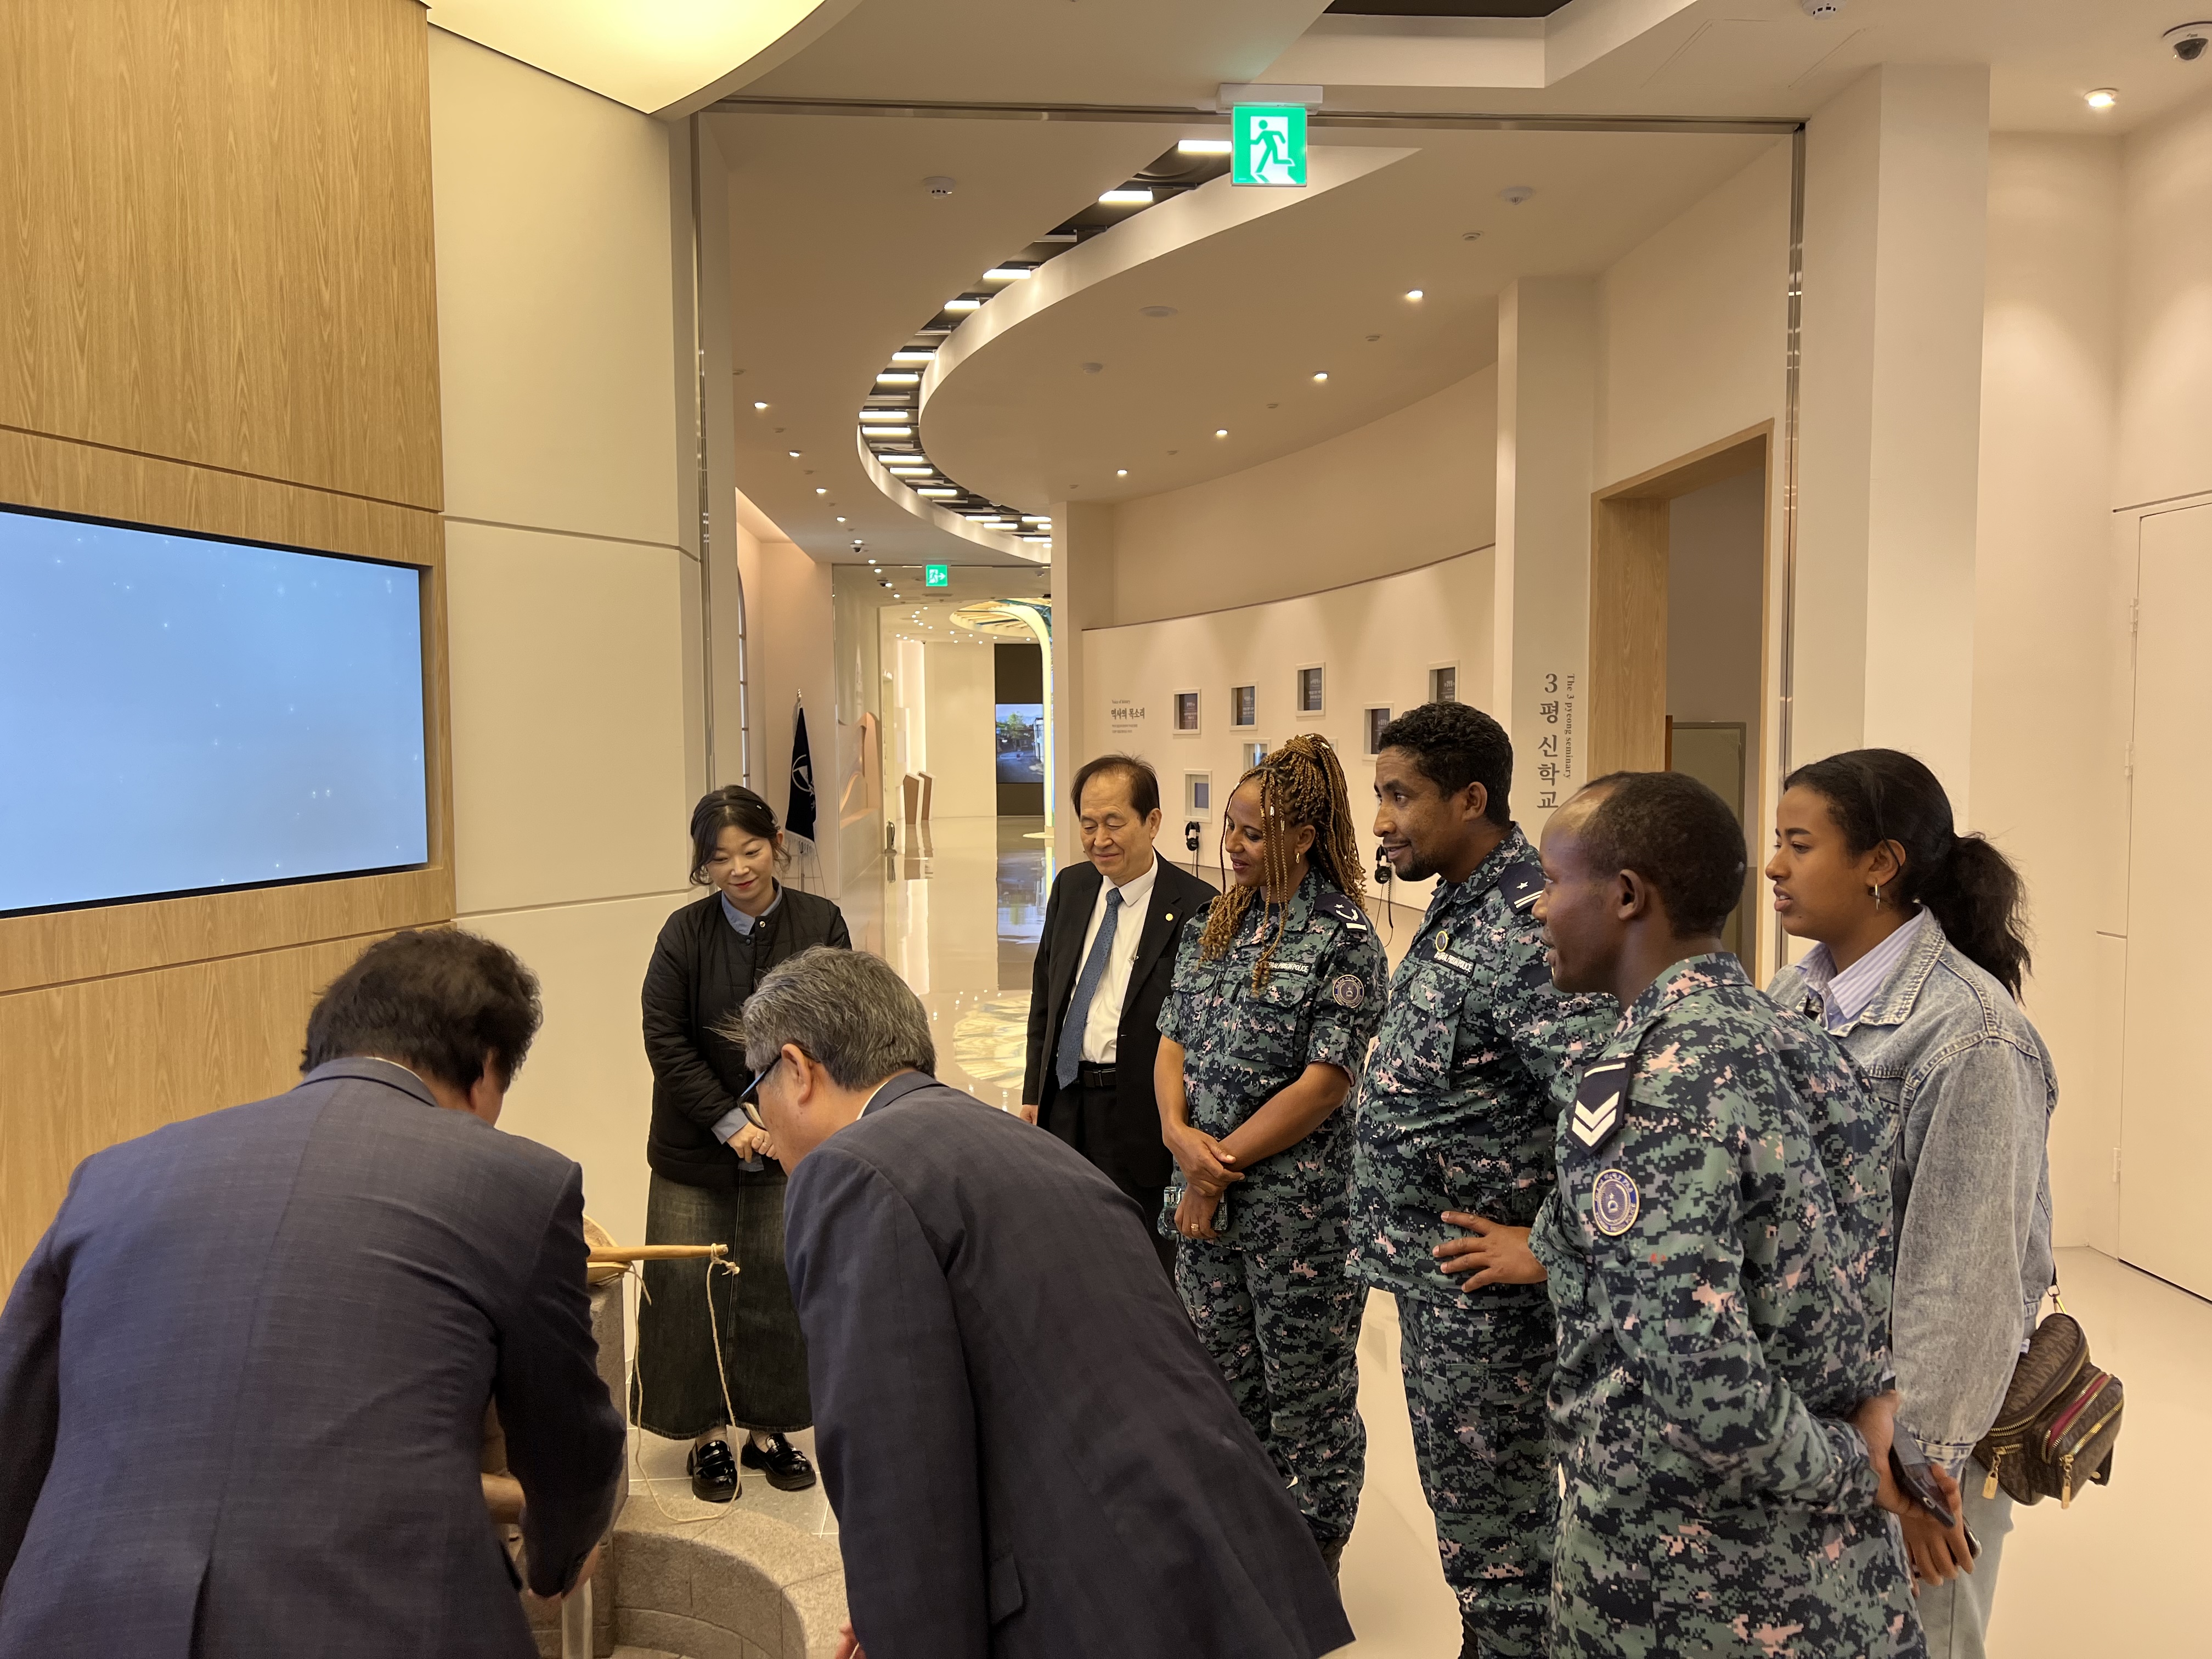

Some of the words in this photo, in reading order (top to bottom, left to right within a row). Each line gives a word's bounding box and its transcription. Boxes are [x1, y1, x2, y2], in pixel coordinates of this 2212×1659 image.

[1567, 673, 1575, 691] The
[1111, 708, 1127, 720] 역사의
[1128, 708, 1145, 720] 목소리
[1564, 702, 1572, 735] pyeong
[1564, 737, 1573, 779] seminary
[1537, 734, 1560, 809] 신학교
[1292, 963, 1309, 973] POLICE
